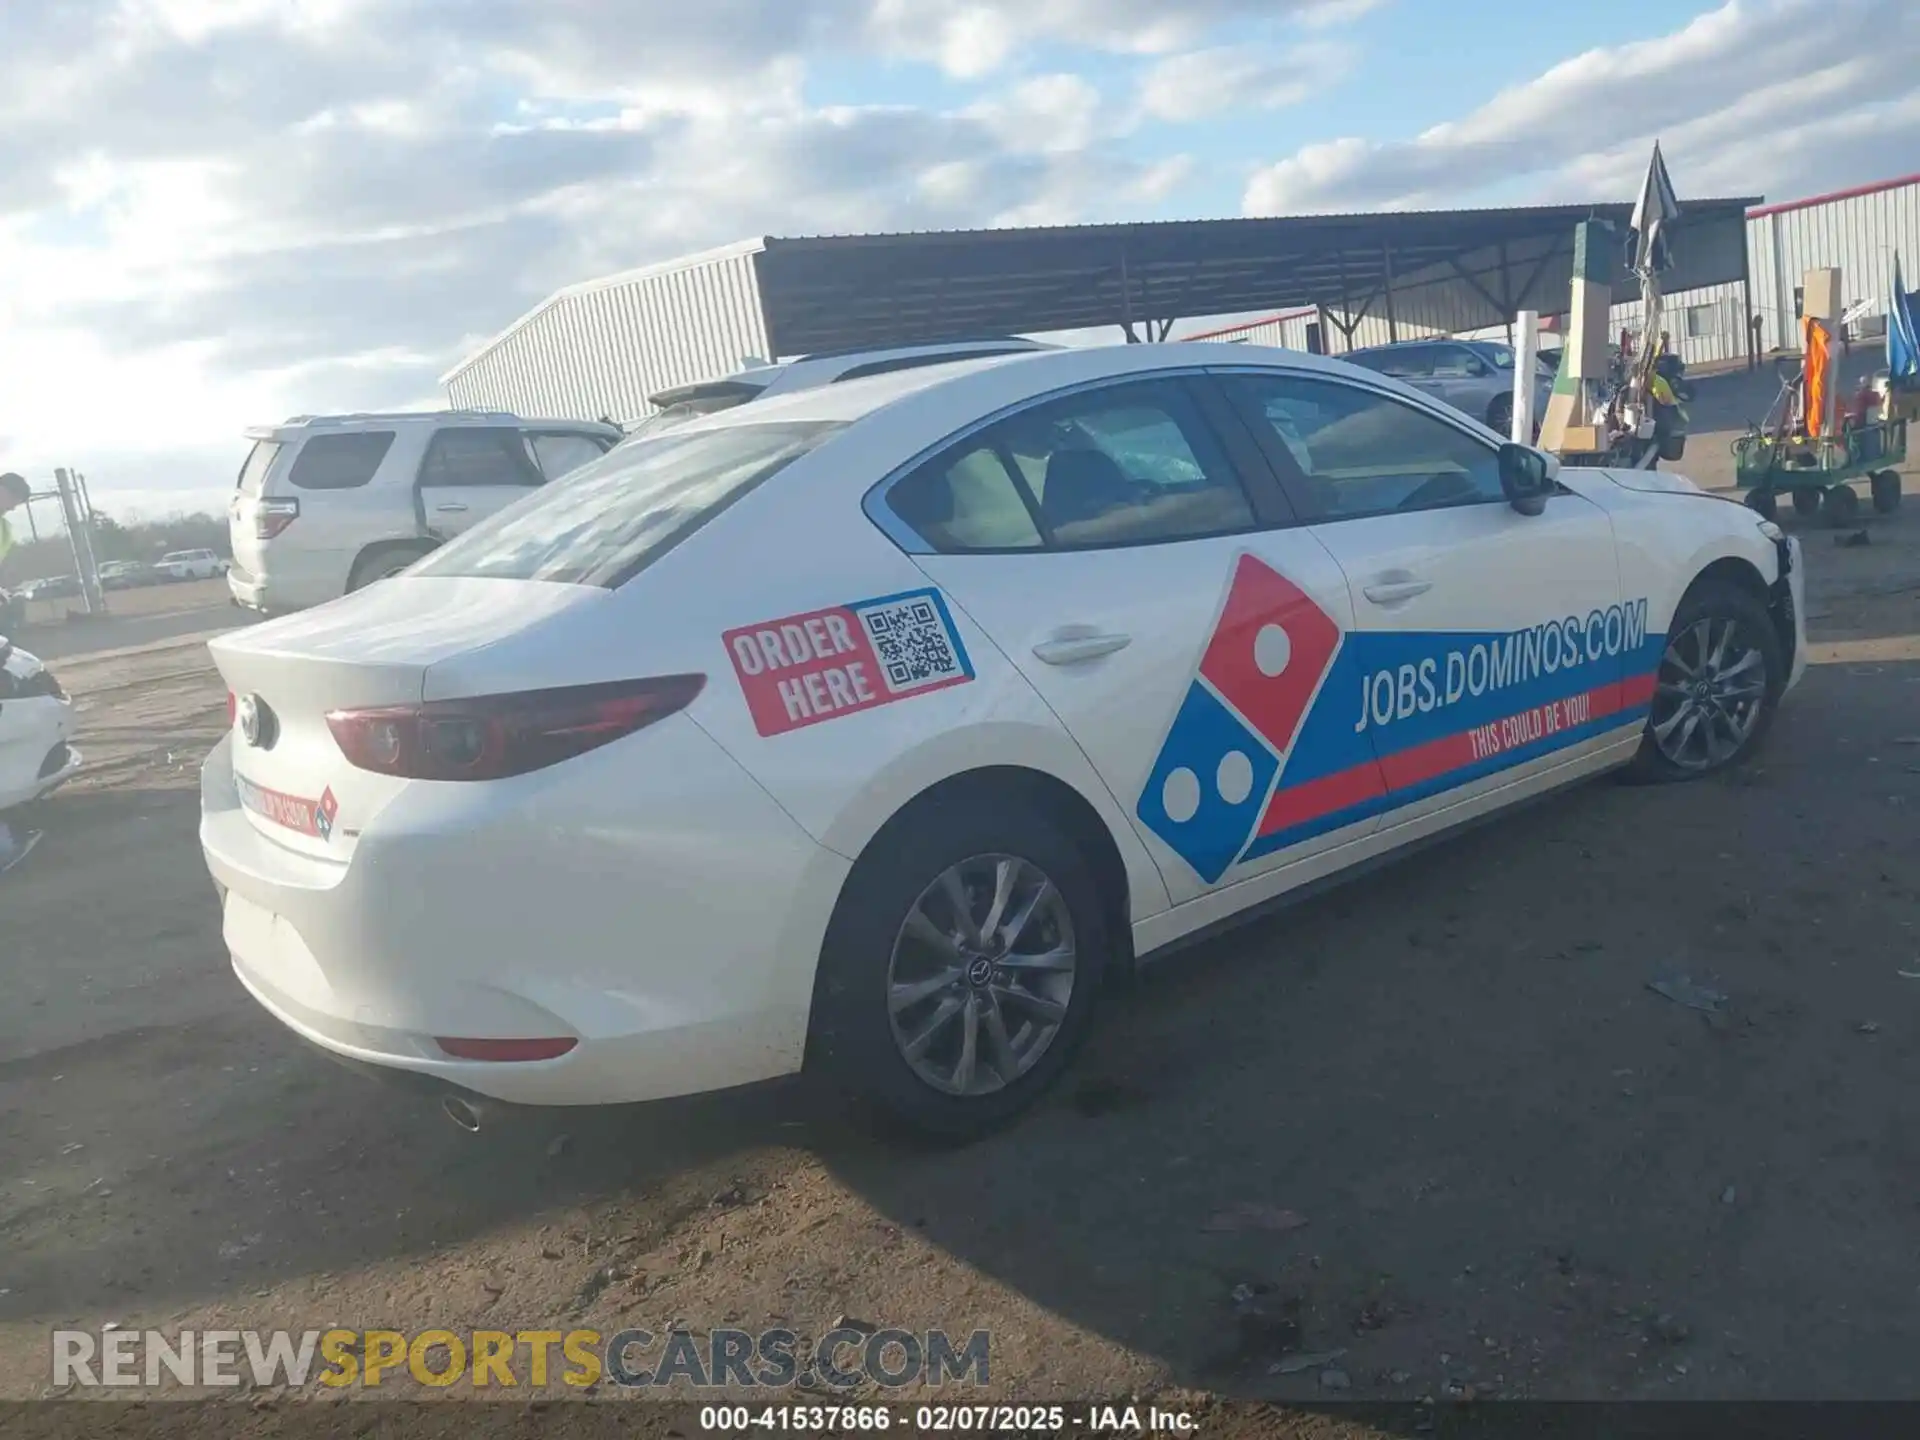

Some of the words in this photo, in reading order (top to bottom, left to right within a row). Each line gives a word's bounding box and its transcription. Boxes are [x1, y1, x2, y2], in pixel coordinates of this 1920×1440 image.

[733, 615, 856, 675] ORDER
[1355, 597, 1648, 733] JOBS.DOMINOS.COM
[777, 662, 875, 722] HERE
[1468, 723, 1500, 760] THIS
[1502, 709, 1542, 749] COULD
[1545, 702, 1561, 733] BE
[1562, 692, 1591, 727] YOU!
